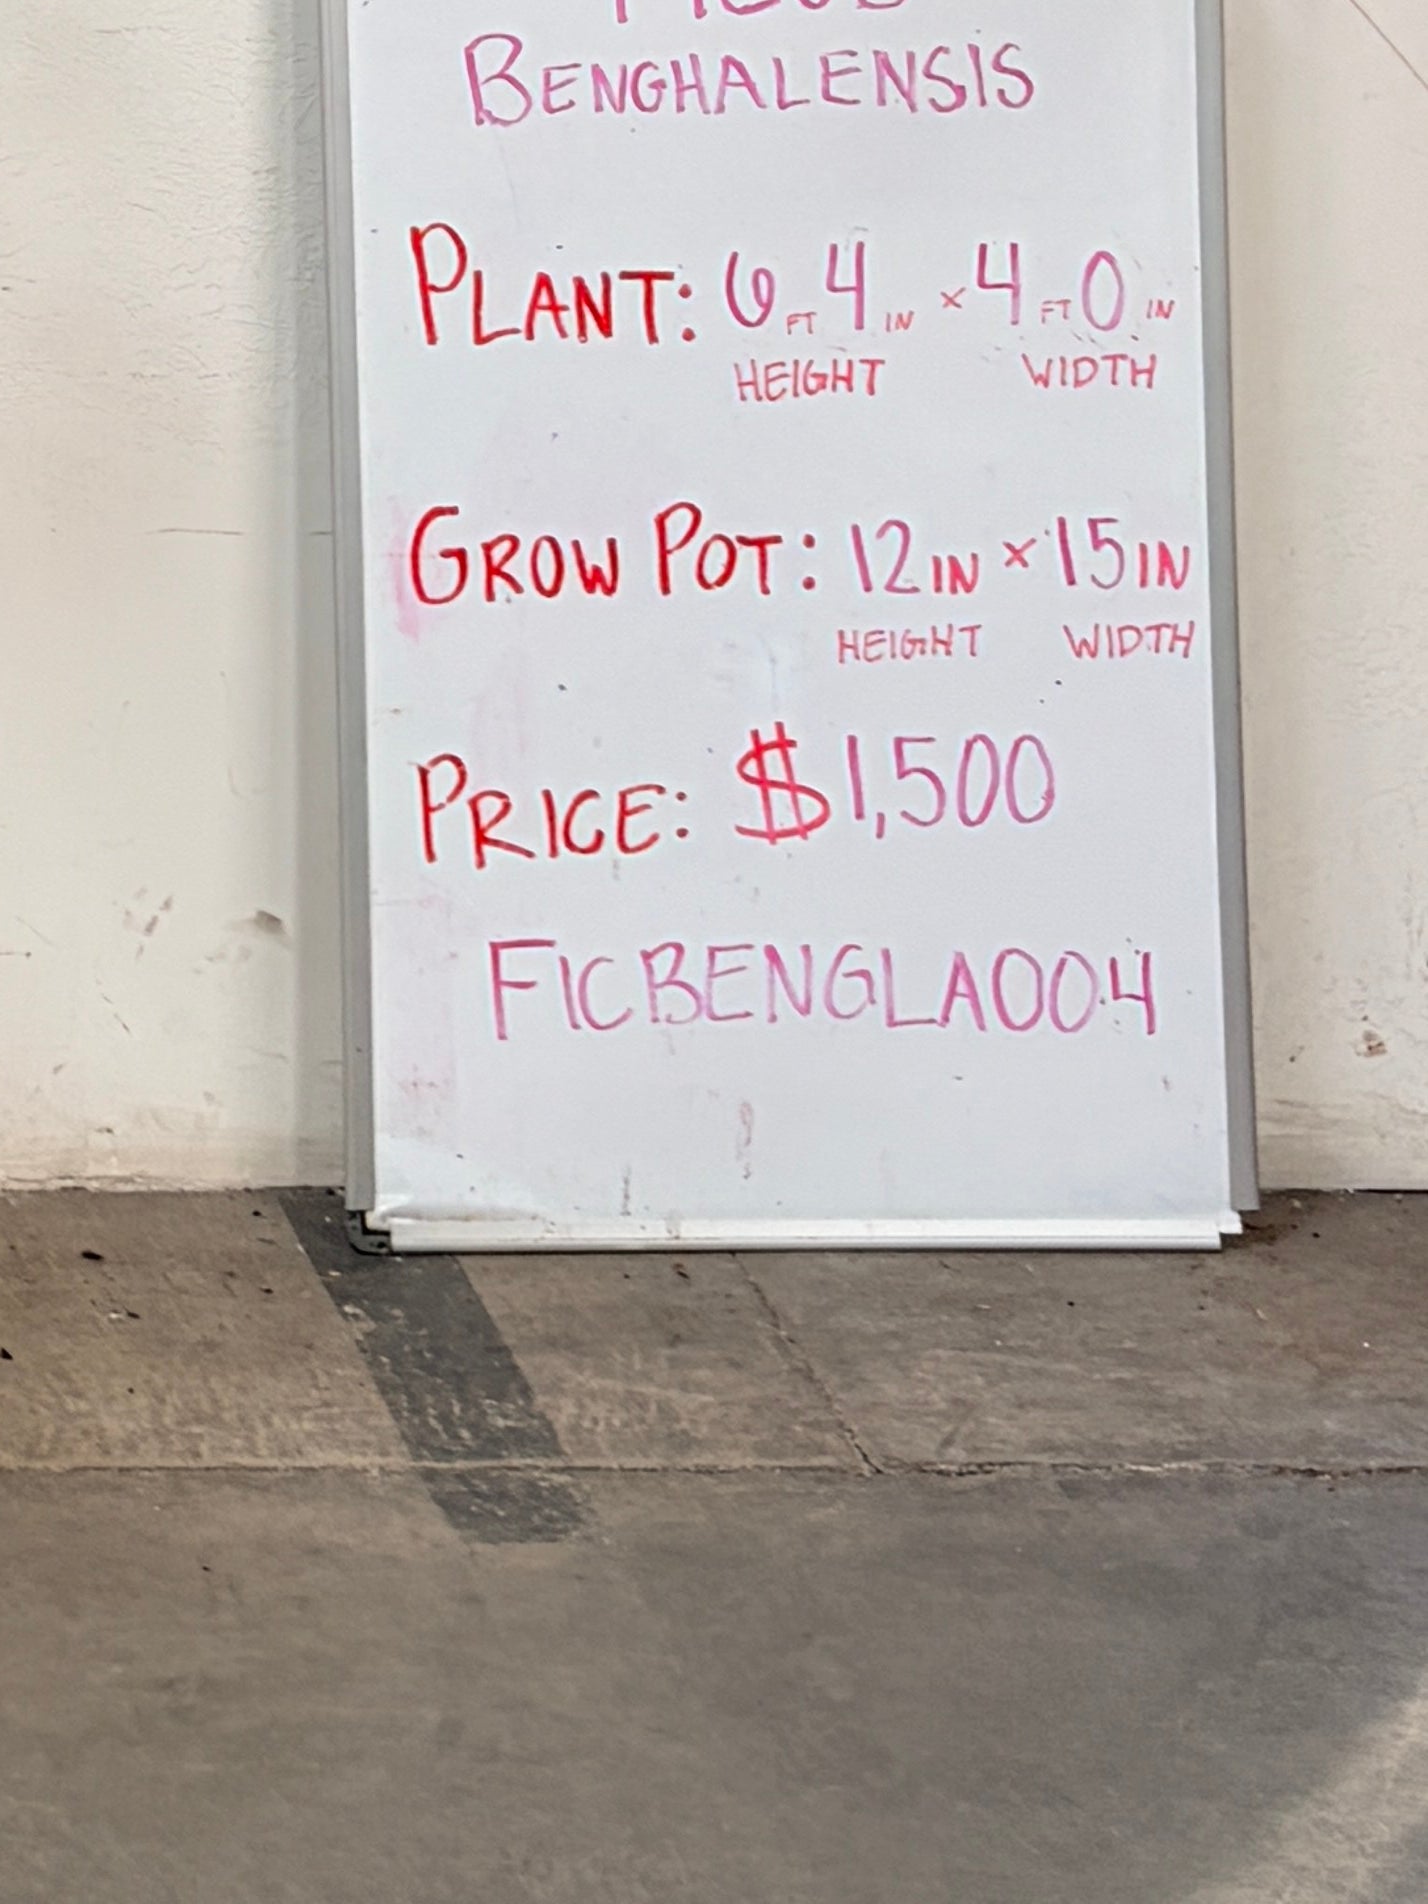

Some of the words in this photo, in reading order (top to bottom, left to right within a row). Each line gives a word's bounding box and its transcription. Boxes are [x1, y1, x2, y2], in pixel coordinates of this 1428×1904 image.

[463, 33, 1034, 127] BENGHALENSIS
[409, 223, 695, 346] PLANT:
[724, 252, 776, 328] 6
[786, 311, 817, 335] FT
[825, 242, 865, 331] 4
[885, 310, 915, 333] IN
[975, 243, 1021, 325] 4
[1040, 299, 1072, 324] FT
[1081, 251, 1125, 332] 0
[1146, 299, 1175, 319] IN
[735, 358, 883, 402] HEIGHT
[1022, 353, 1156, 389] WIDTH
[406, 506, 619, 607] GROW
[653, 502, 816, 596] POT:
[850, 520, 919, 595] 12
[931, 553, 980, 595] IN
[1055, 516, 1125, 590] 15
[1138, 541, 1189, 591] IN
[836, 624, 982, 664] HEIGHT
[1063, 623, 1195, 659] WIDTH
[417, 754, 688, 870] PRICE:
[735, 722, 1055, 846] $1,500
[488, 938, 1156, 1041] FICBENGLA004
